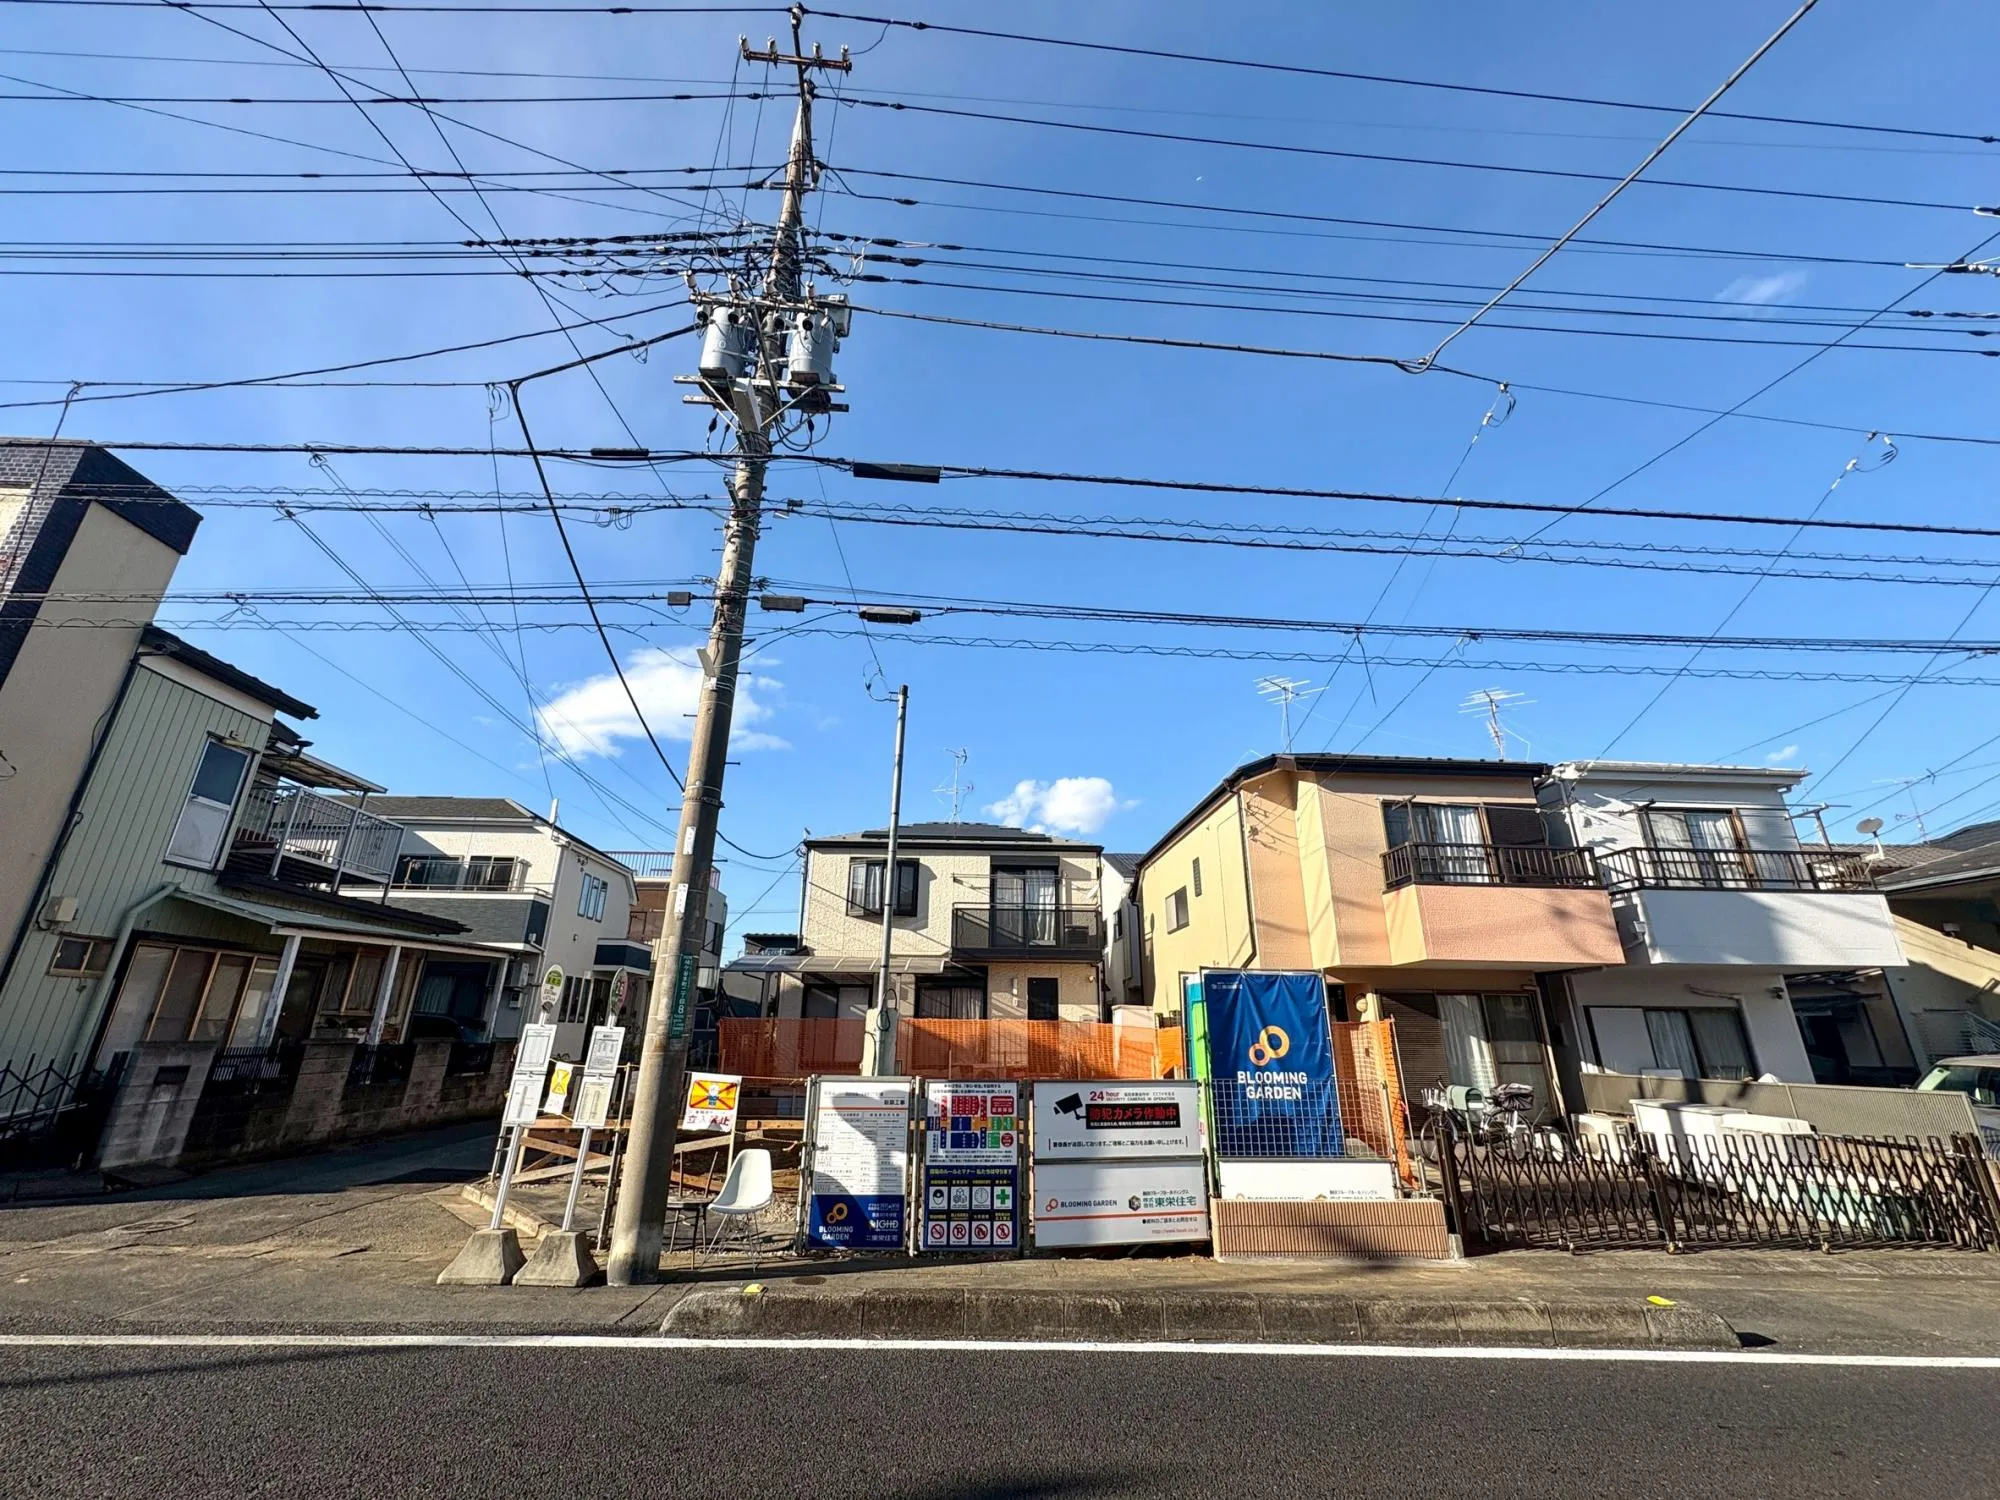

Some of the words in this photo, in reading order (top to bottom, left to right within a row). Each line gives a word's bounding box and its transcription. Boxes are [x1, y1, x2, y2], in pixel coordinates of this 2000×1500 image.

[1237, 1071, 1308, 1085] BLOOMING
[1089, 1091, 1104, 1101] 24
[1246, 1085, 1302, 1100] GARDEN
[1089, 1106, 1177, 1120] 防犯カメラ作動中
[1060, 1200, 1092, 1208] BLOOMING
[1092, 1199, 1117, 1207] GARDEN
[1155, 1196, 1197, 1207] 東栄住宅
[818, 1225, 854, 1233] BLOOMING
[821, 1233, 850, 1241] GARDEN
